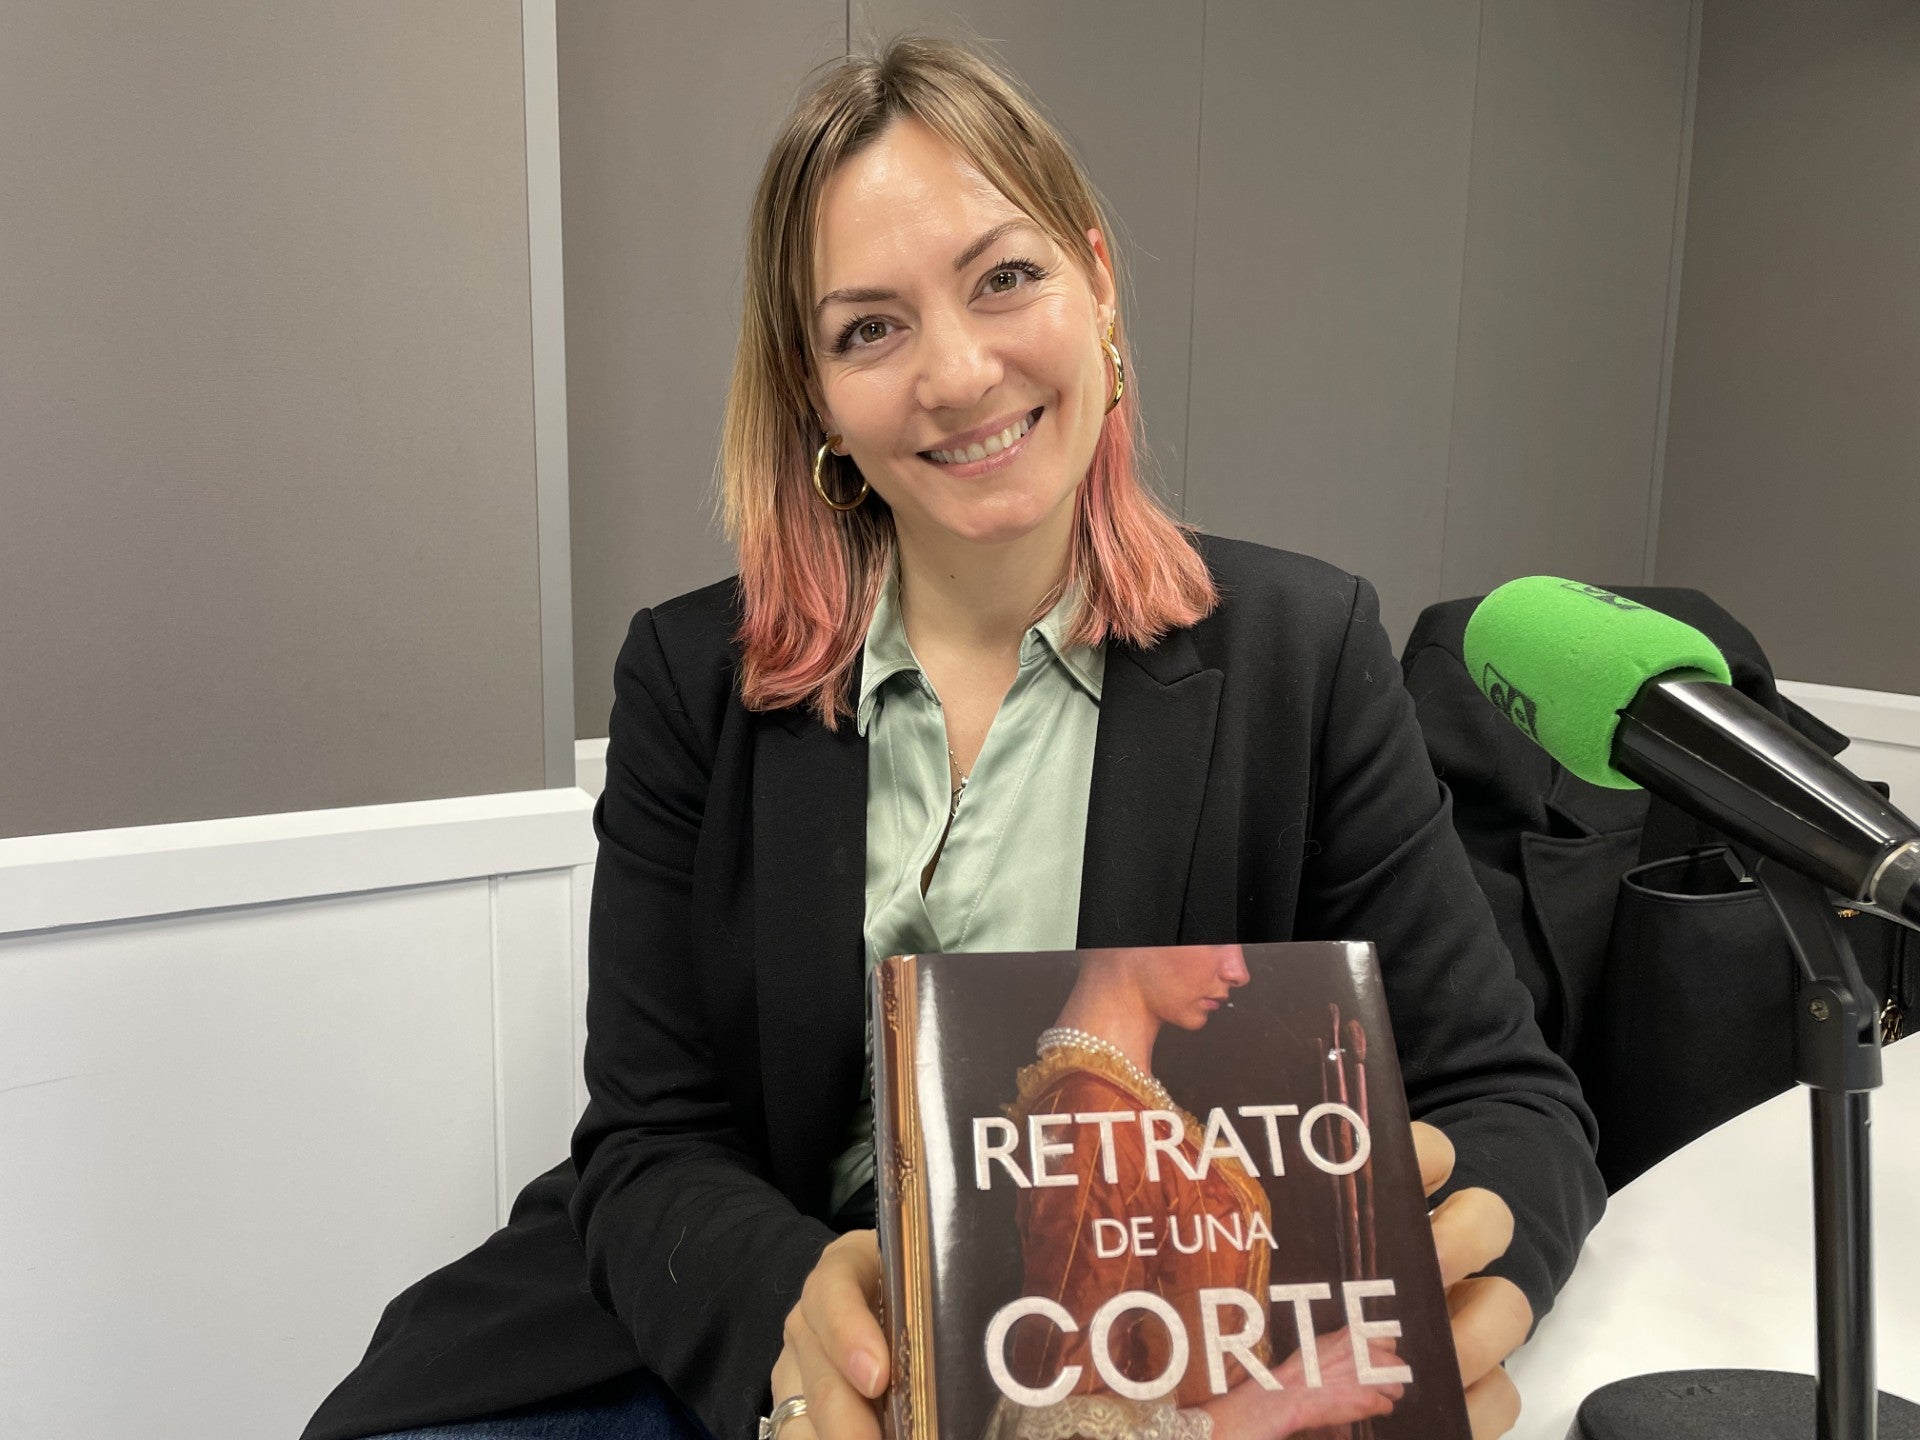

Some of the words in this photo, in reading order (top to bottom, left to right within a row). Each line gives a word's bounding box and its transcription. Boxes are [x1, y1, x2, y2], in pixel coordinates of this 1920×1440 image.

[973, 1103, 1371, 1190] RETRATO
[1093, 1217, 1158, 1259] DE
[1171, 1211, 1279, 1255] UNA
[985, 1280, 1413, 1408] CORTE
